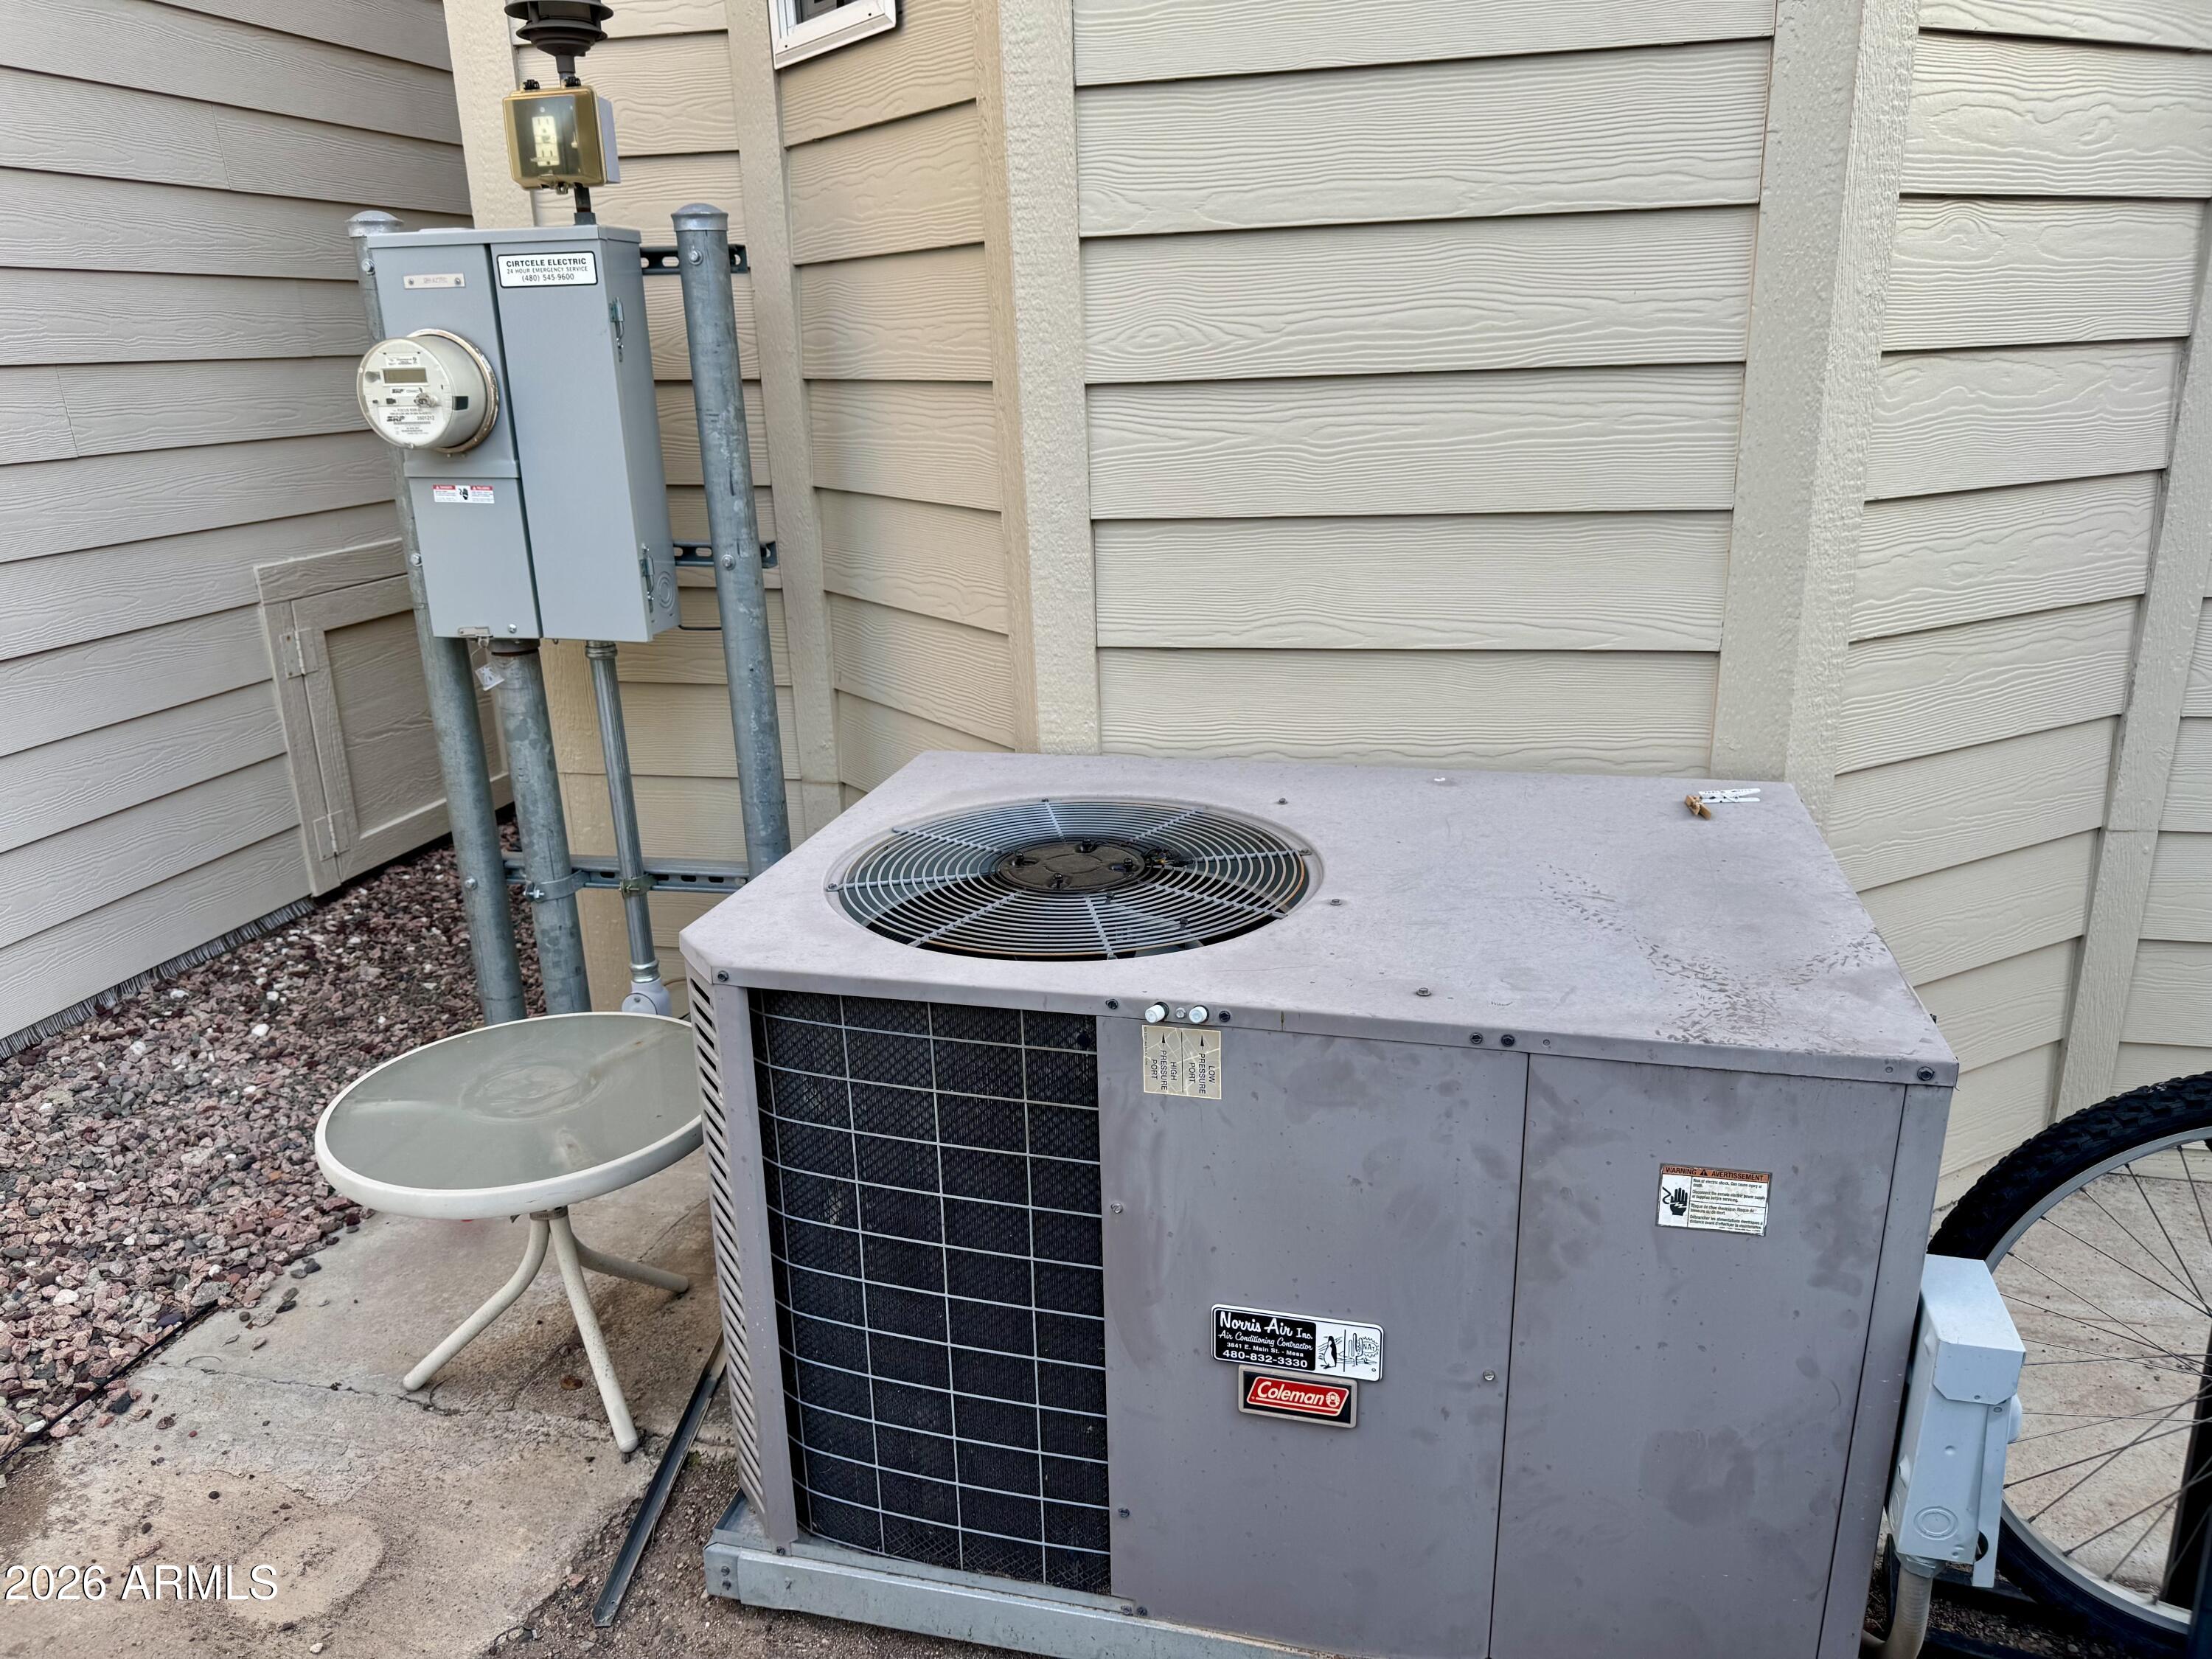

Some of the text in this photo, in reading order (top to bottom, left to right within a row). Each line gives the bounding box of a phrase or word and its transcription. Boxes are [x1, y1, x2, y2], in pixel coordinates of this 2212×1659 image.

[522, 274, 540, 282] (480)
[1666, 1166, 1764, 1181] WARNING AVERTISSEMENT
[1220, 1311, 1313, 1340] Norris Air Inc.
[1217, 1330, 1314, 1351] Air Conditioning Contractor
[1222, 1349, 1308, 1368] 480-832-3330
[1286, 1349, 1304, 1357] Mesa
[1257, 1381, 1324, 1406] Coleman
